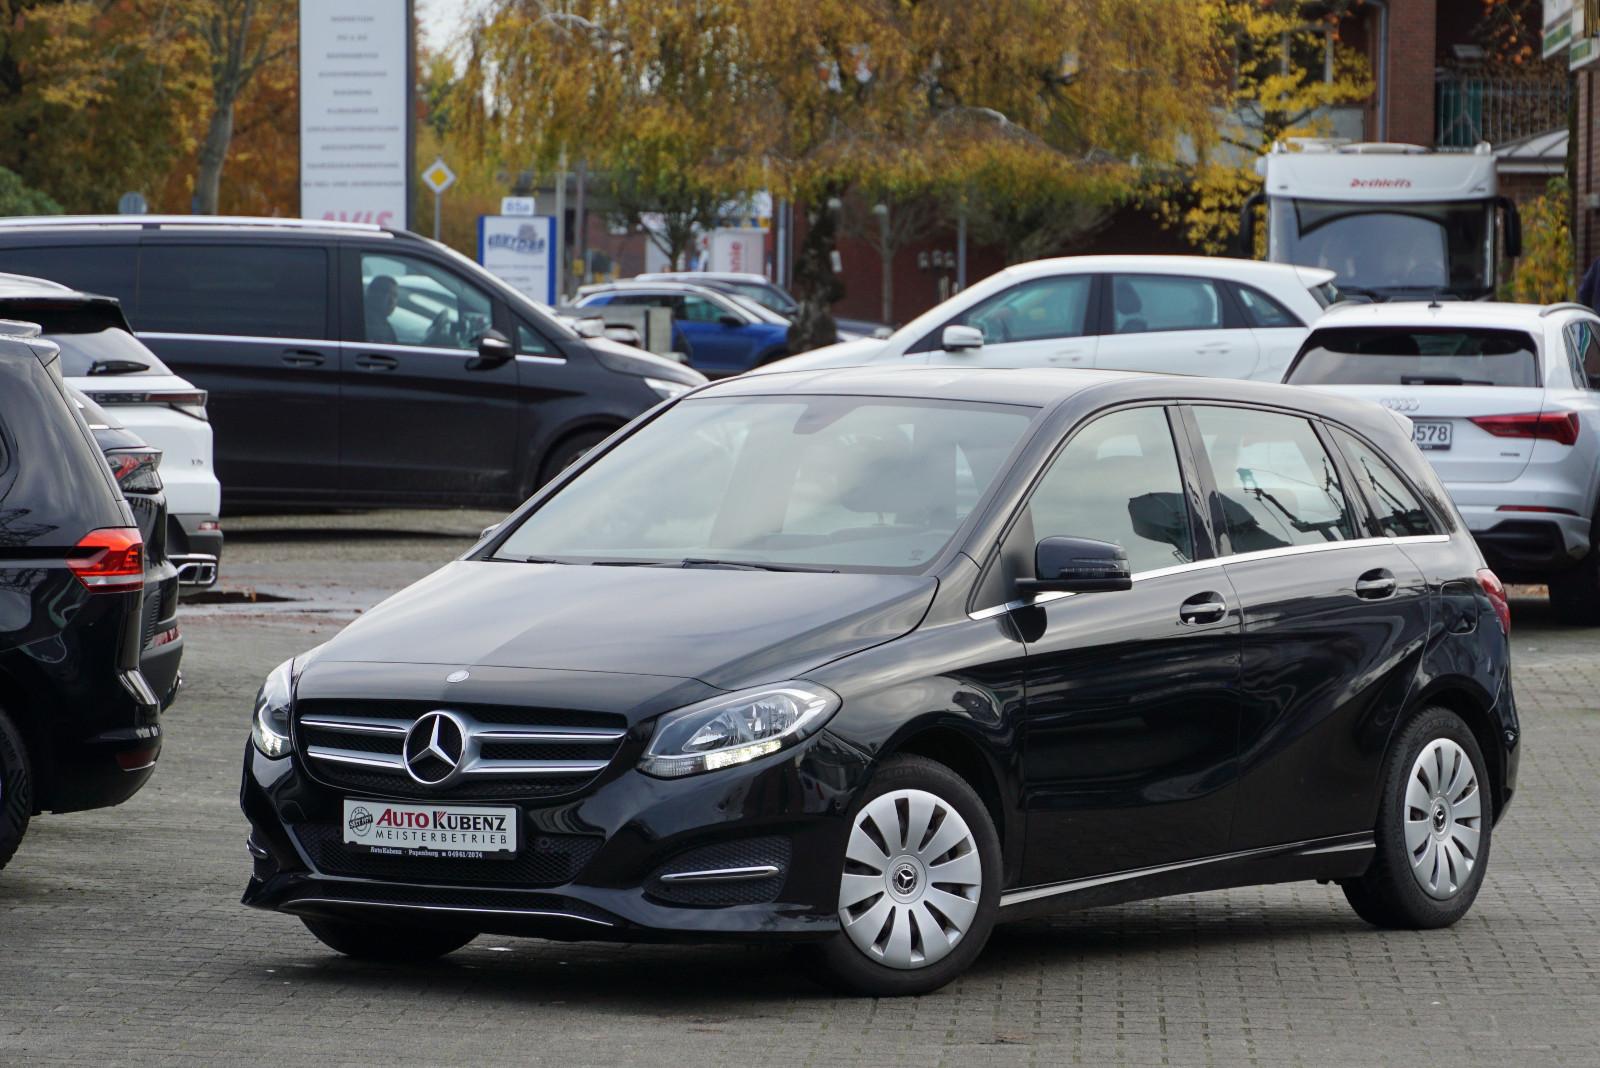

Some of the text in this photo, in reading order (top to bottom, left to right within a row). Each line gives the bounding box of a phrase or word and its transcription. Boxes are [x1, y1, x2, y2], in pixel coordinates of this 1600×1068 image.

[1412, 425, 1448, 442] 578
[375, 808, 507, 832] AUTO KUBENZ
[375, 830, 507, 844] MEISTERBETRIEB
